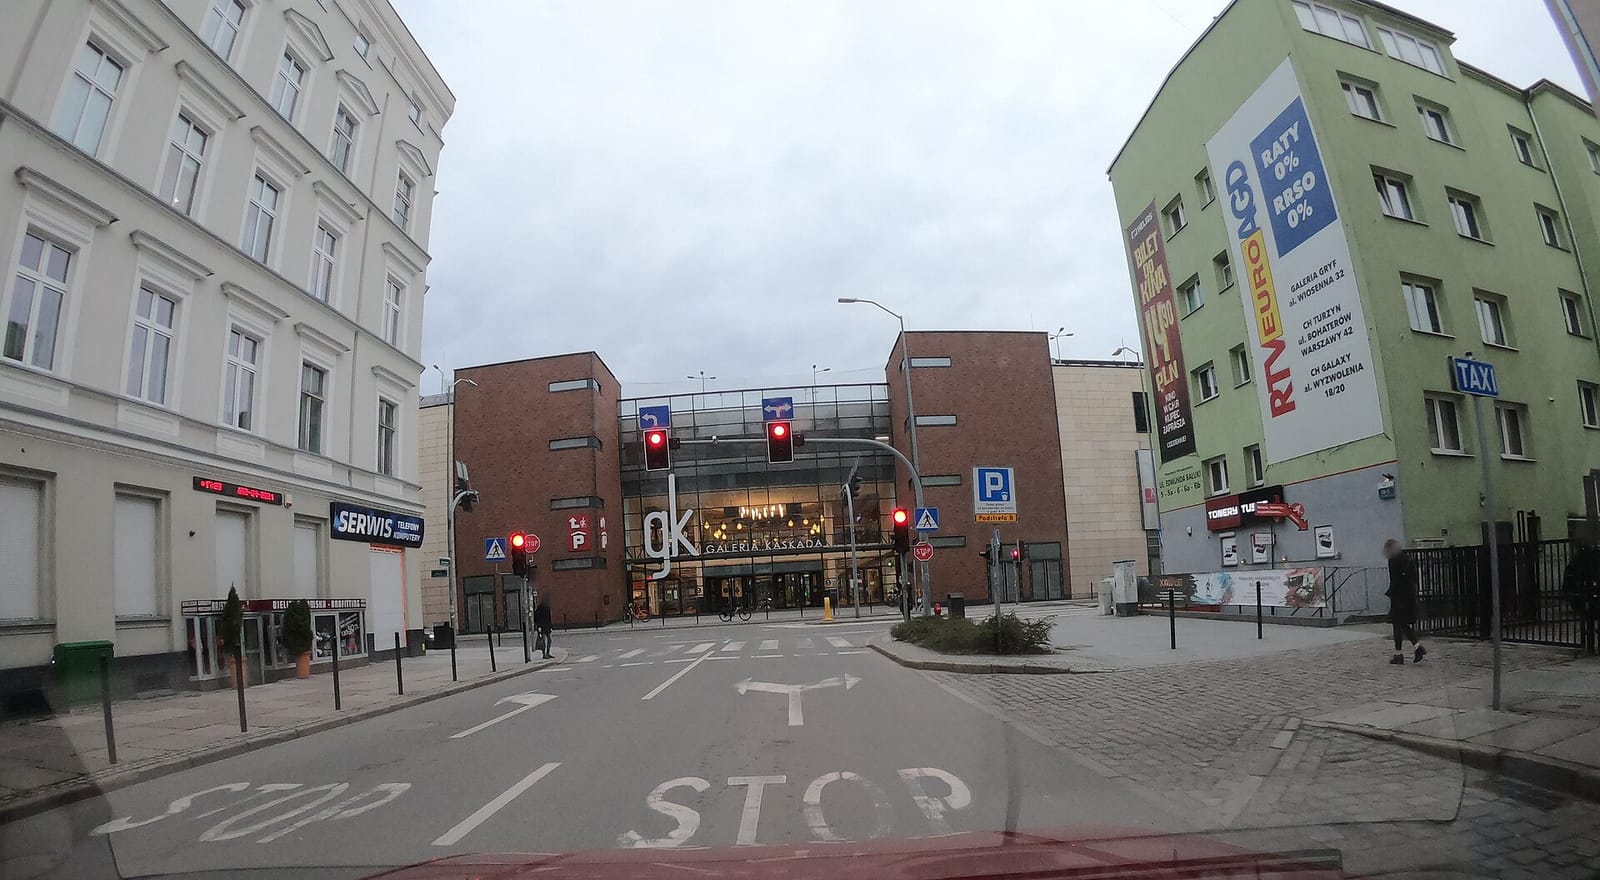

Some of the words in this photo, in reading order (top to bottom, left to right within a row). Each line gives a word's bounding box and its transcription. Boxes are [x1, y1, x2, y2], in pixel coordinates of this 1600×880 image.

[1261, 121, 1300, 168] RATY
[1274, 151, 1300, 181] 0%
[1225, 160, 1258, 240] AGD
[1272, 171, 1316, 215] RRSO
[1287, 199, 1314, 229] 0%
[1134, 230, 1159, 270] BILET
[1140, 263, 1168, 305] KINA
[1142, 259, 1155, 280] DO
[1290, 272, 1318, 293] GALERIA
[1319, 259, 1338, 276] GRYF
[1247, 239, 1277, 337] EURO
[1289, 297, 1297, 307] al.
[1297, 275, 1335, 302] WIOSENNA
[1335, 269, 1345, 281] 32
[1298, 335, 1307, 346] ul.
[1307, 312, 1353, 342] BOHATERÓW
[1302, 318, 1313, 330] CH
[1313, 304, 1342, 325] TURZYN
[1300, 330, 1342, 357] WARSZAWY
[1343, 326, 1354, 338] 42
[1155, 360, 1179, 392] PLN
[1261, 338, 1296, 418] RTV
[1310, 366, 1321, 377] CH
[1321, 353, 1352, 373] GALAXY
[1313, 362, 1364, 389] WYZWOLENIA
[1457, 362, 1498, 393] TAXI
[1324, 383, 1346, 398] 18/20
[1163, 418, 1186, 435] ZAPRASZA
[985, 472, 1003, 498] P
[337, 510, 393, 538] SERWIS
[397, 520, 420, 532] TELEFONY
[1207, 506, 1239, 519] TONERY
[392, 531, 421, 542] KOMPUTERY
[706, 542, 759, 554] GALERIA
[765, 538, 823, 551] KASKADA
[916, 548, 931, 556] STOP
[88, 782, 412, 844] STOP
[617, 767, 971, 850] STOP
